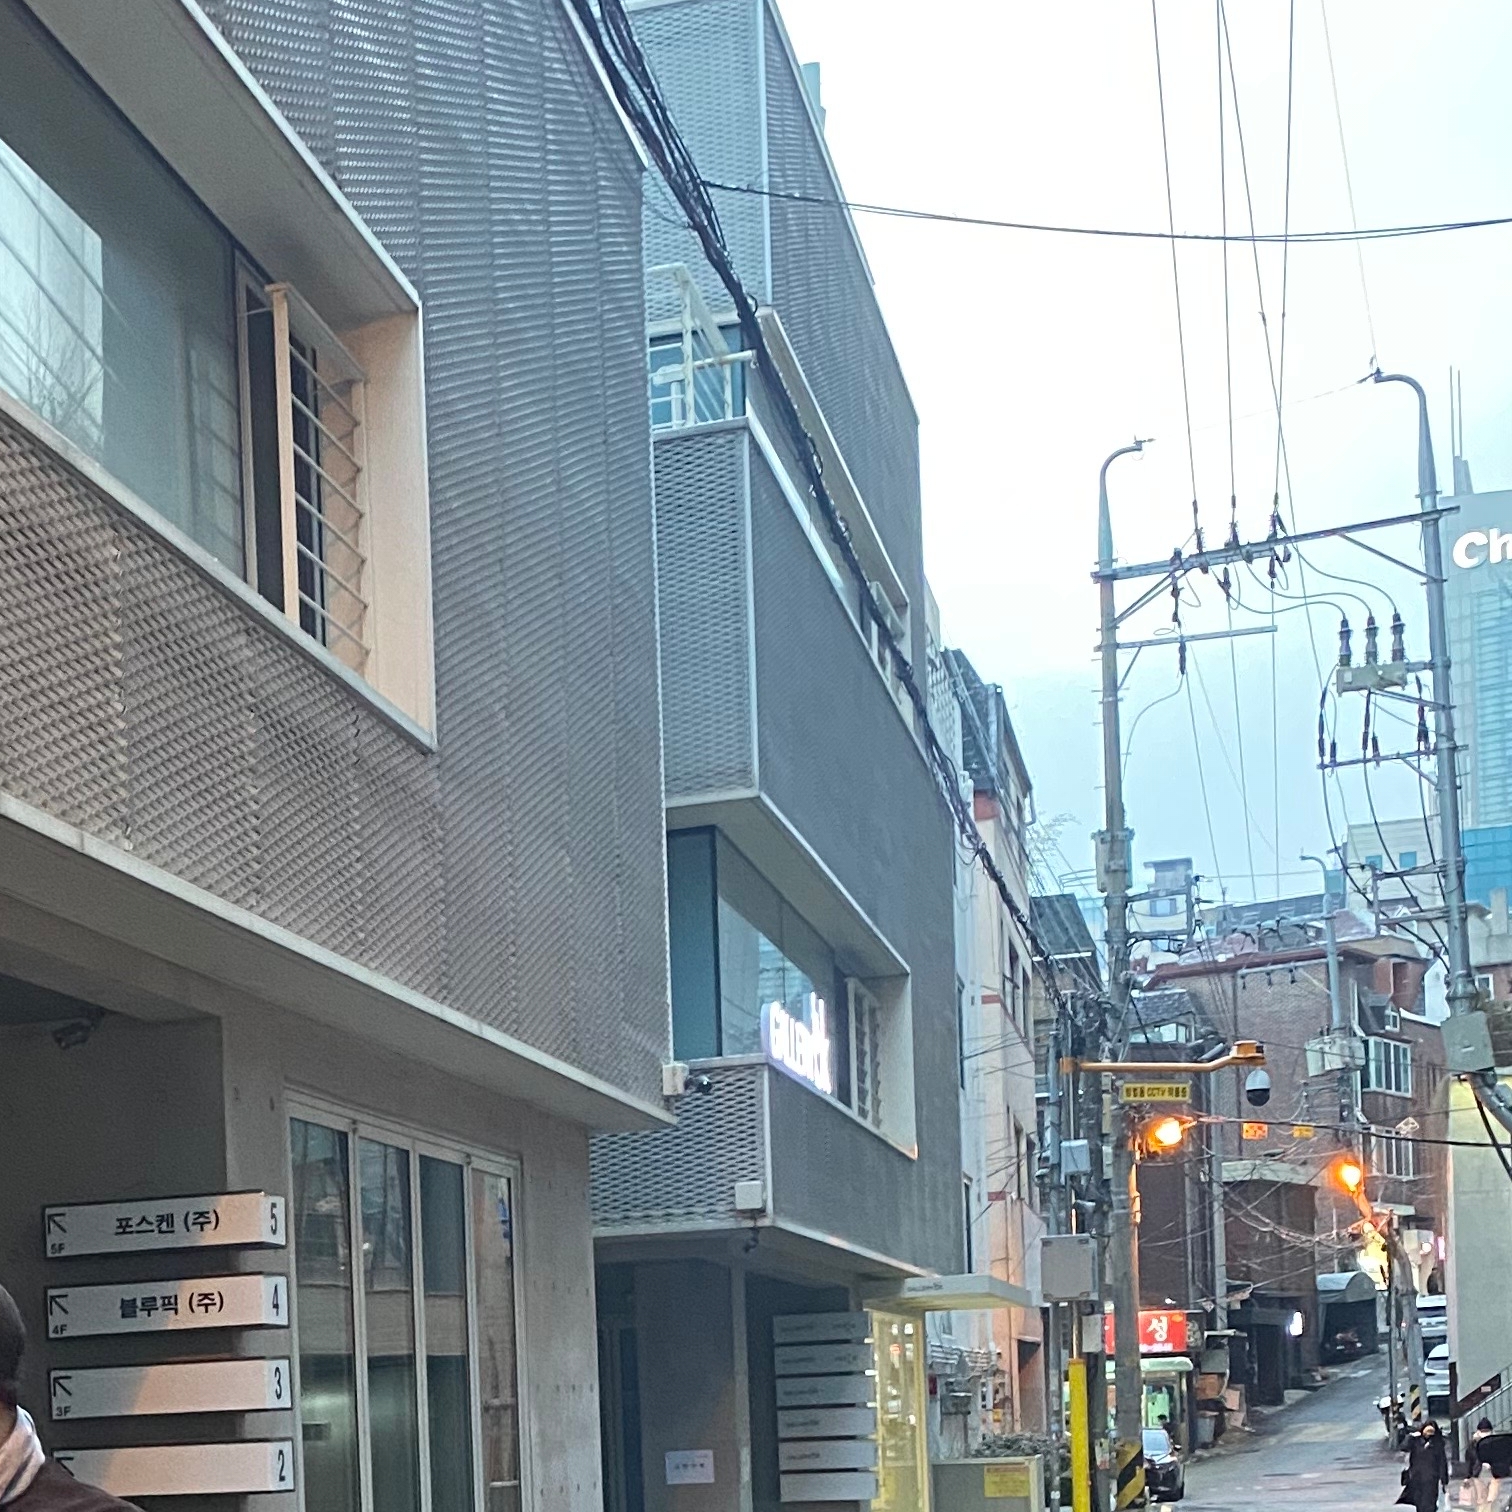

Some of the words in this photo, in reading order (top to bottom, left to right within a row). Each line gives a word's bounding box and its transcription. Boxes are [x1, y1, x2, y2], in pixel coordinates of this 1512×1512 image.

[114, 1212, 176, 1236] 포스켄
[183, 1209, 220, 1233] (주)
[269, 1202, 278, 1236] 5
[50, 1242, 65, 1255] 5F
[188, 1291, 224, 1314] (주)
[271, 1284, 280, 1317] 4
[51, 1324, 68, 1336] 4F
[274, 1366, 283, 1400] 3
[55, 1405, 72, 1417] 3F
[277, 1449, 286, 1482] 2
